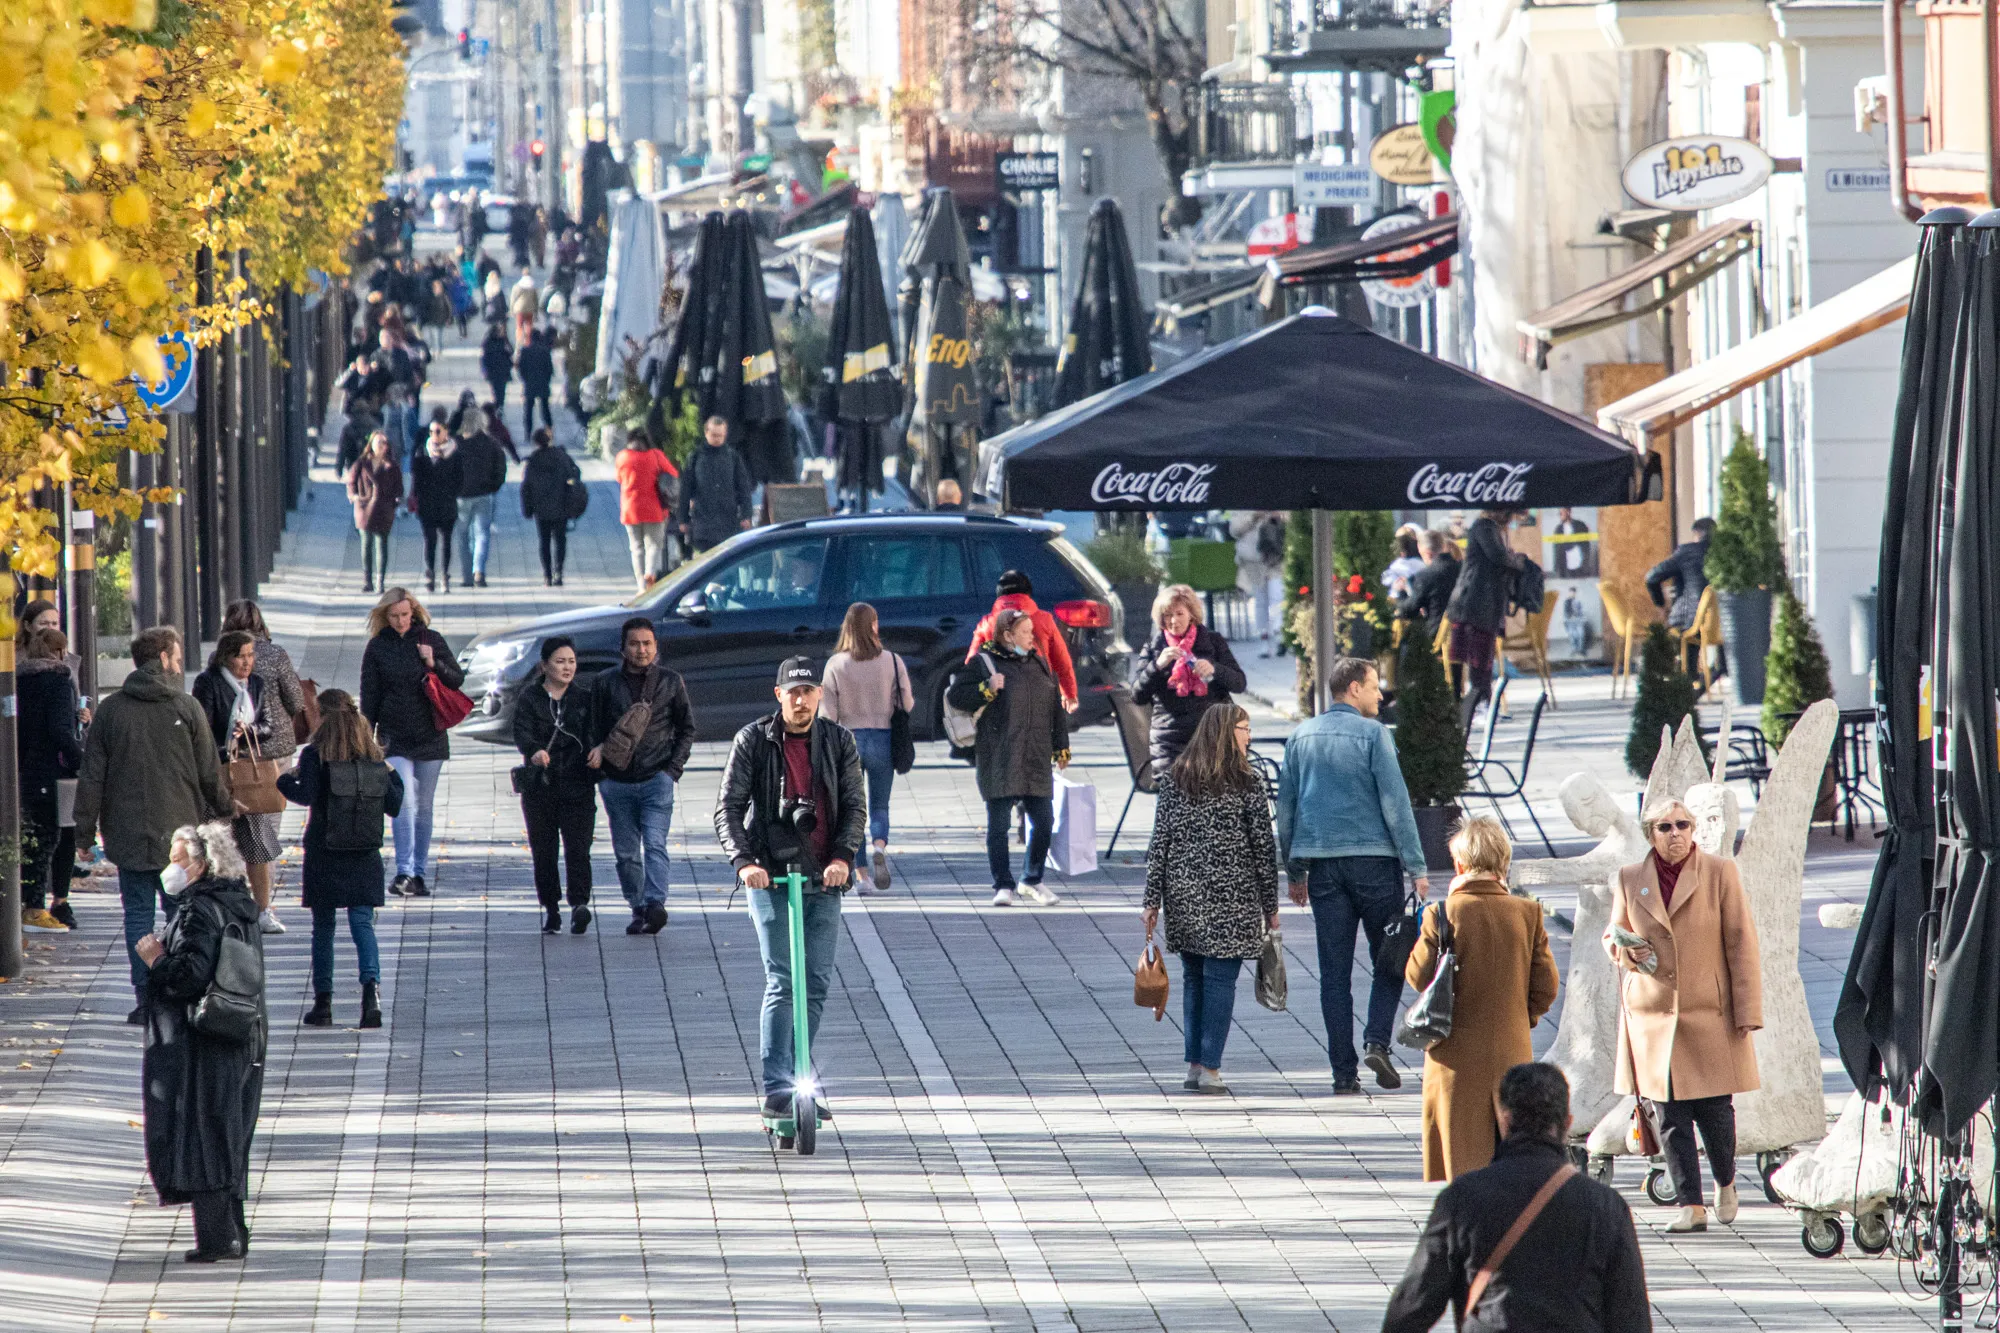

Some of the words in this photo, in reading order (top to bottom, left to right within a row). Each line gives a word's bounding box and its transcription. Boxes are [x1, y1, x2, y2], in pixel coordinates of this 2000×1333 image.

[1000, 158, 1057, 174] CHARLIE
[1665, 143, 1721, 171] 101
[1303, 170, 1369, 182] MEDICINOS
[1091, 463, 1217, 503] Coca-Cola
[1407, 463, 1534, 504] Coca-Cola
[788, 669, 812, 678] NASA
